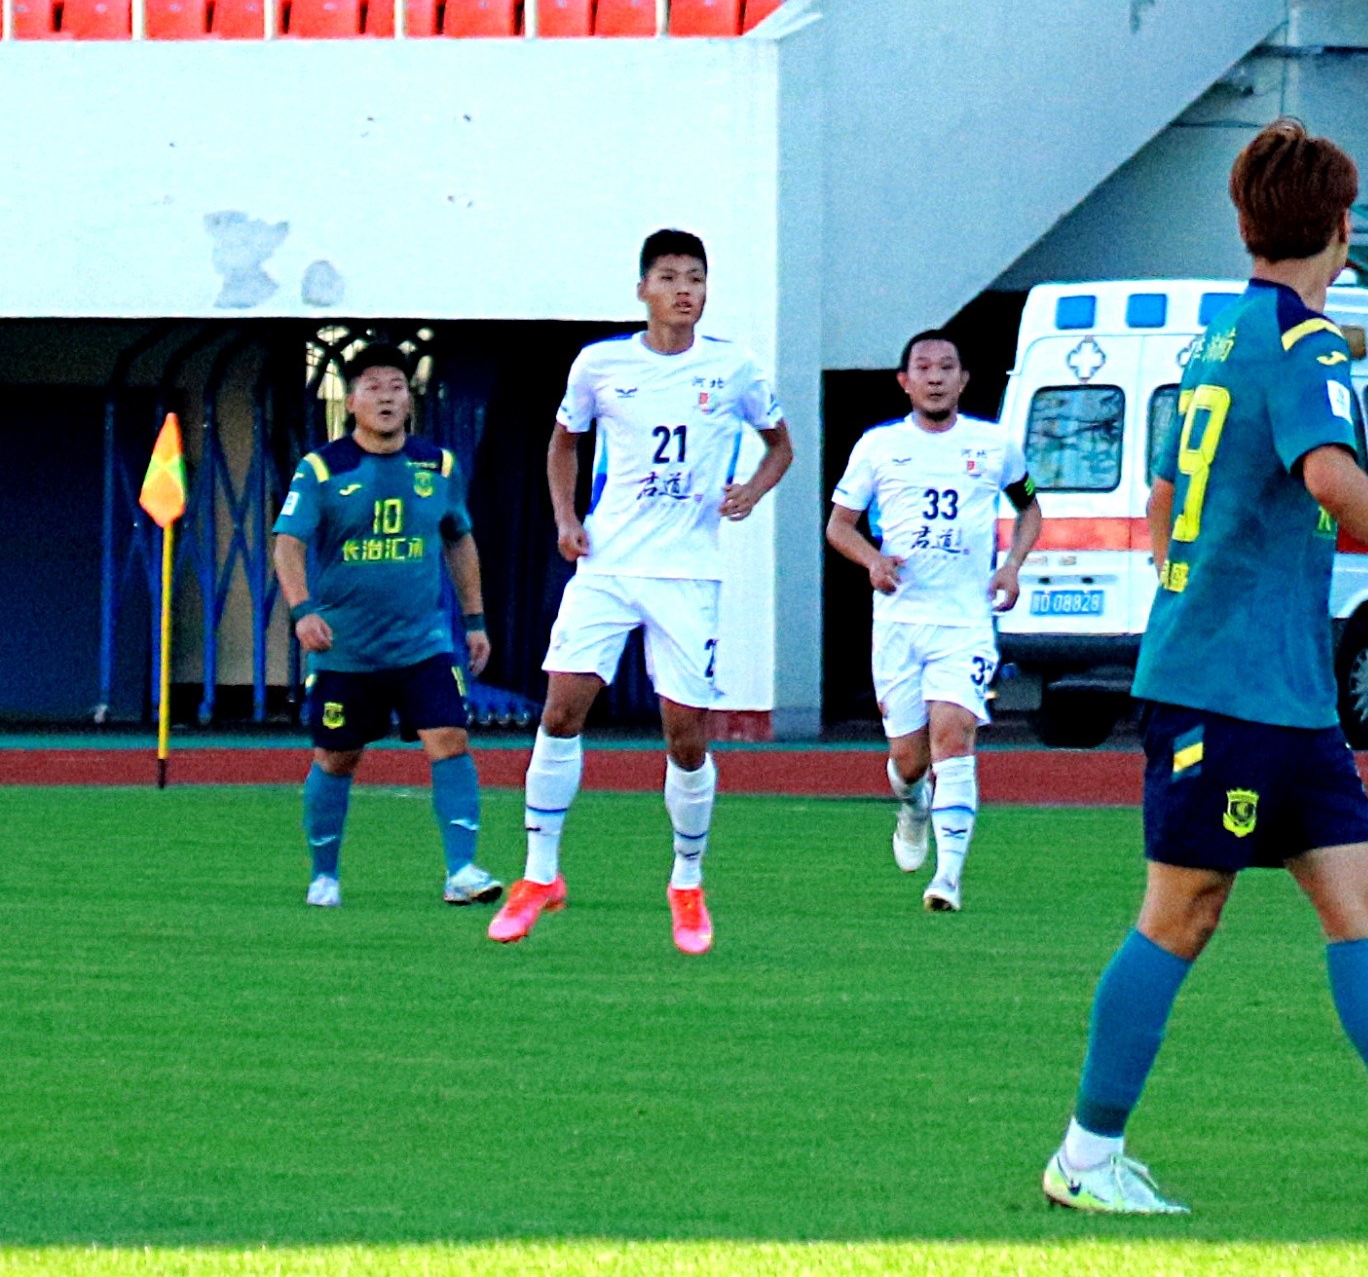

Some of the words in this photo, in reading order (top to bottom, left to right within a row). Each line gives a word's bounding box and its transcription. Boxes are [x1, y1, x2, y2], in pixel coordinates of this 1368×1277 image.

[652, 424, 687, 464] 21
[1172, 384, 1231, 542] 9
[372, 498, 403, 535] 10
[922, 488, 959, 520] 33
